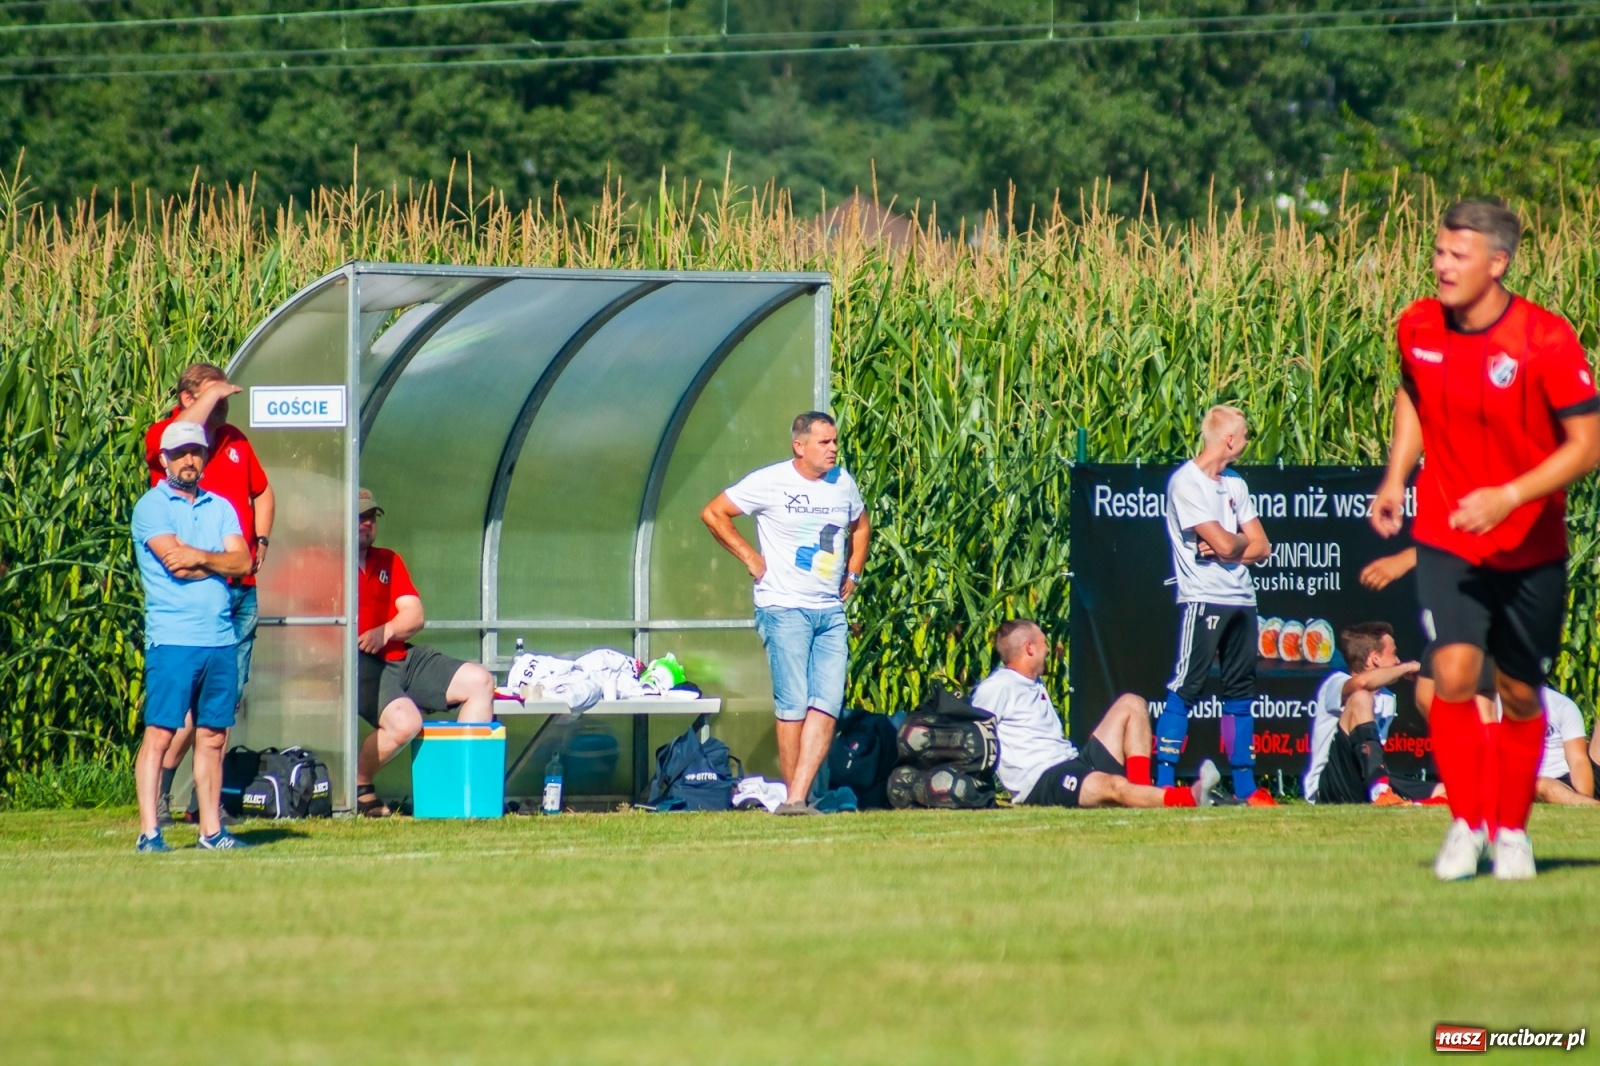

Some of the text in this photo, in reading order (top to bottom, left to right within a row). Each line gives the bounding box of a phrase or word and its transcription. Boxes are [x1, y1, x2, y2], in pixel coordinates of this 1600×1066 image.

[267, 396, 328, 415] GOŚCIE
[1095, 484, 1167, 517] Restau
[1294, 486, 1328, 518] niż
[786, 504, 830, 514] house
[1255, 542, 1341, 567] KINAWA
[1205, 615, 1221, 630] 17
[696, 772, 718, 781] errea
[1063, 775, 1077, 791] 5
[242, 794, 266, 805] SELECT
